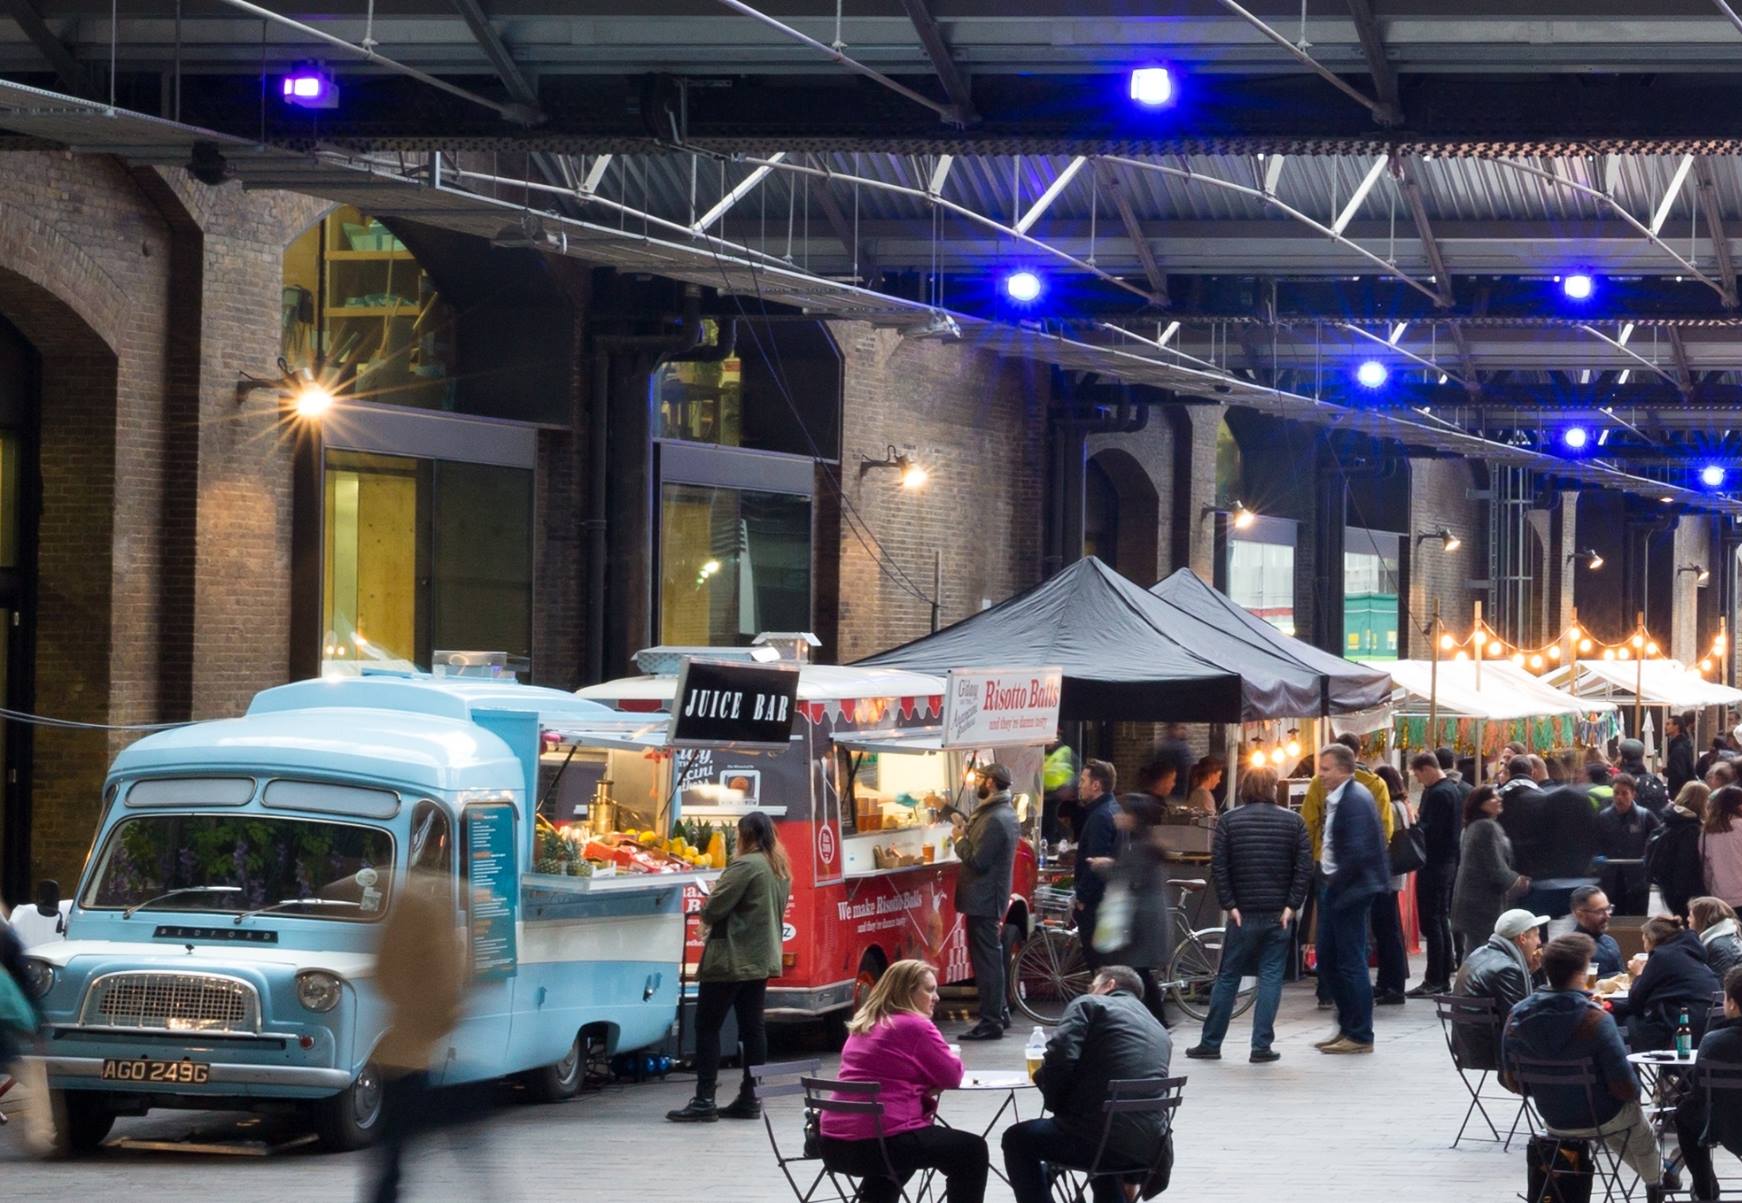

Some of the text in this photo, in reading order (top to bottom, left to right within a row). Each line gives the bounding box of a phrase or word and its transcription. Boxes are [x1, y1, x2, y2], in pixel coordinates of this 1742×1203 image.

[685, 689, 789, 722] JUICE BAR
[983, 679, 1059, 711] Risotto Balls
[837, 901, 851, 920] We
[853, 898, 875, 918] make
[160, 927, 271, 940] BEDFORD
[103, 1061, 209, 1082] AGO 249G
